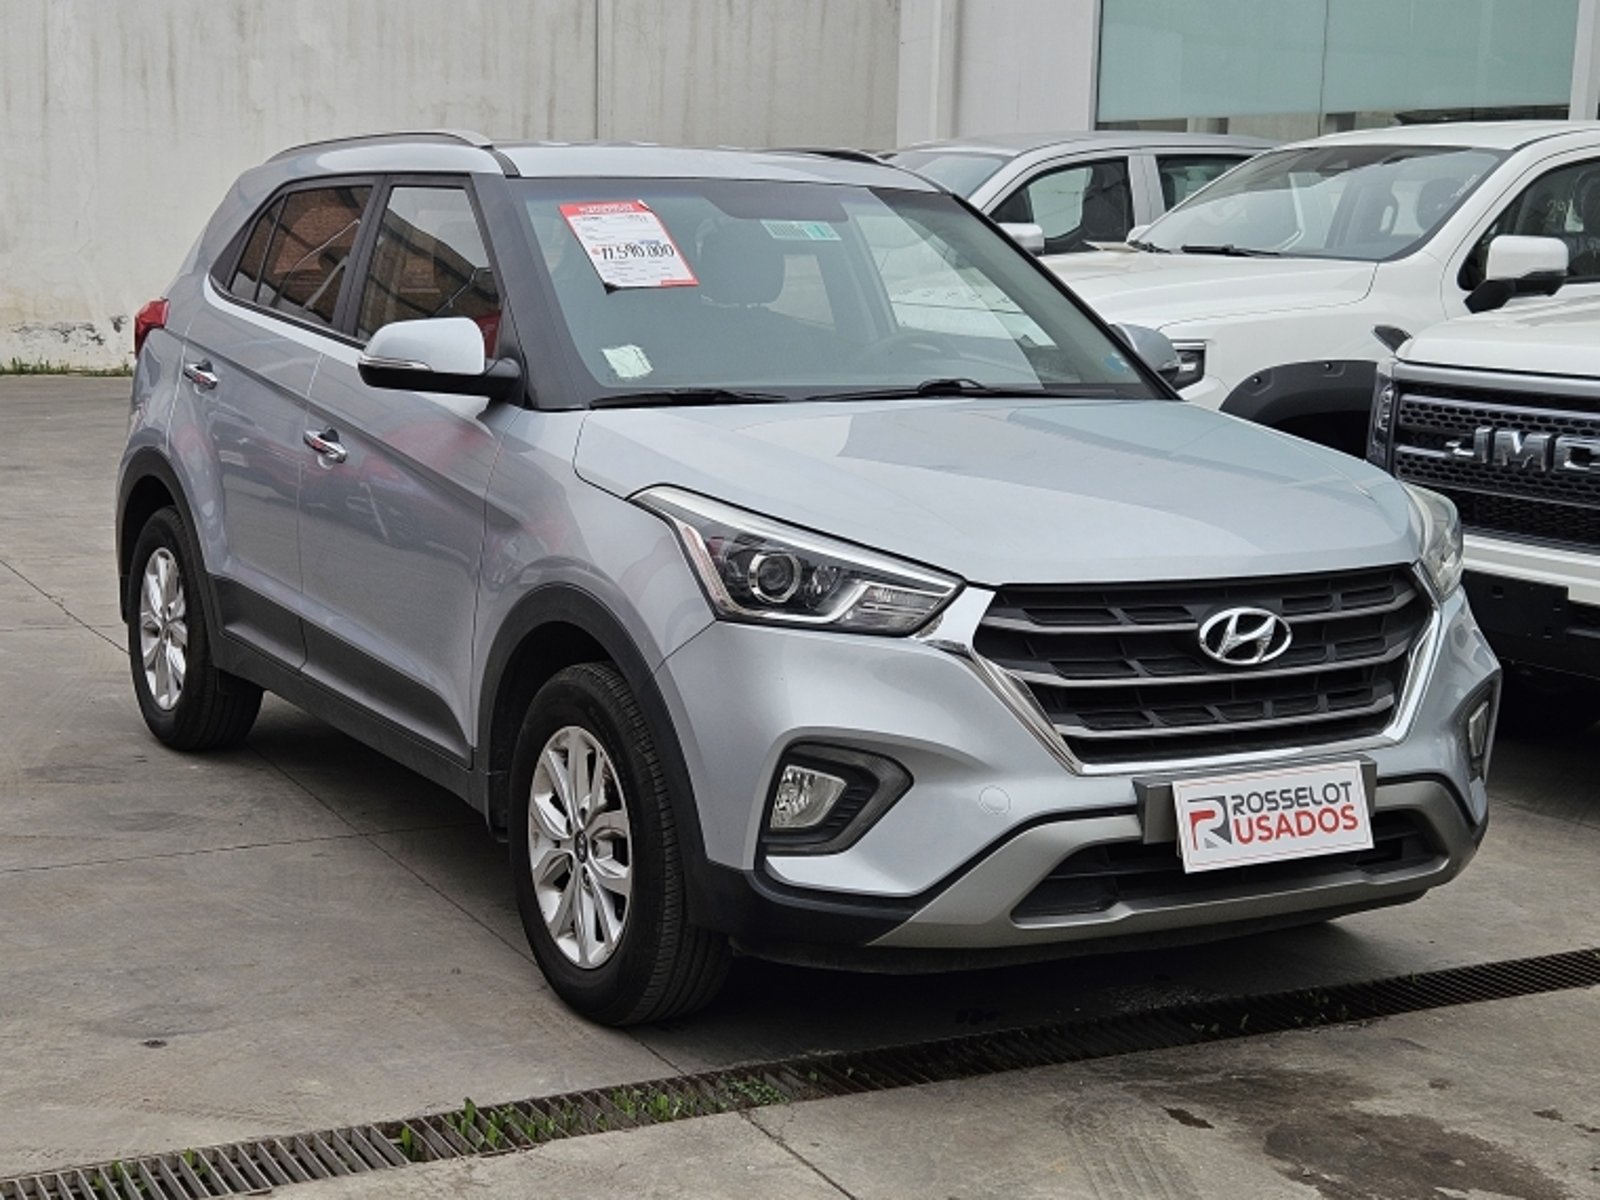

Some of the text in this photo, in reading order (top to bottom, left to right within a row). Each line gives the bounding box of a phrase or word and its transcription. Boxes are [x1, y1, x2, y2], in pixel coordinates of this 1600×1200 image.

[1445, 425, 1600, 474] JMC
[1231, 782, 1352, 815] ROSSELOT
[1234, 805, 1359, 845] USADOS
